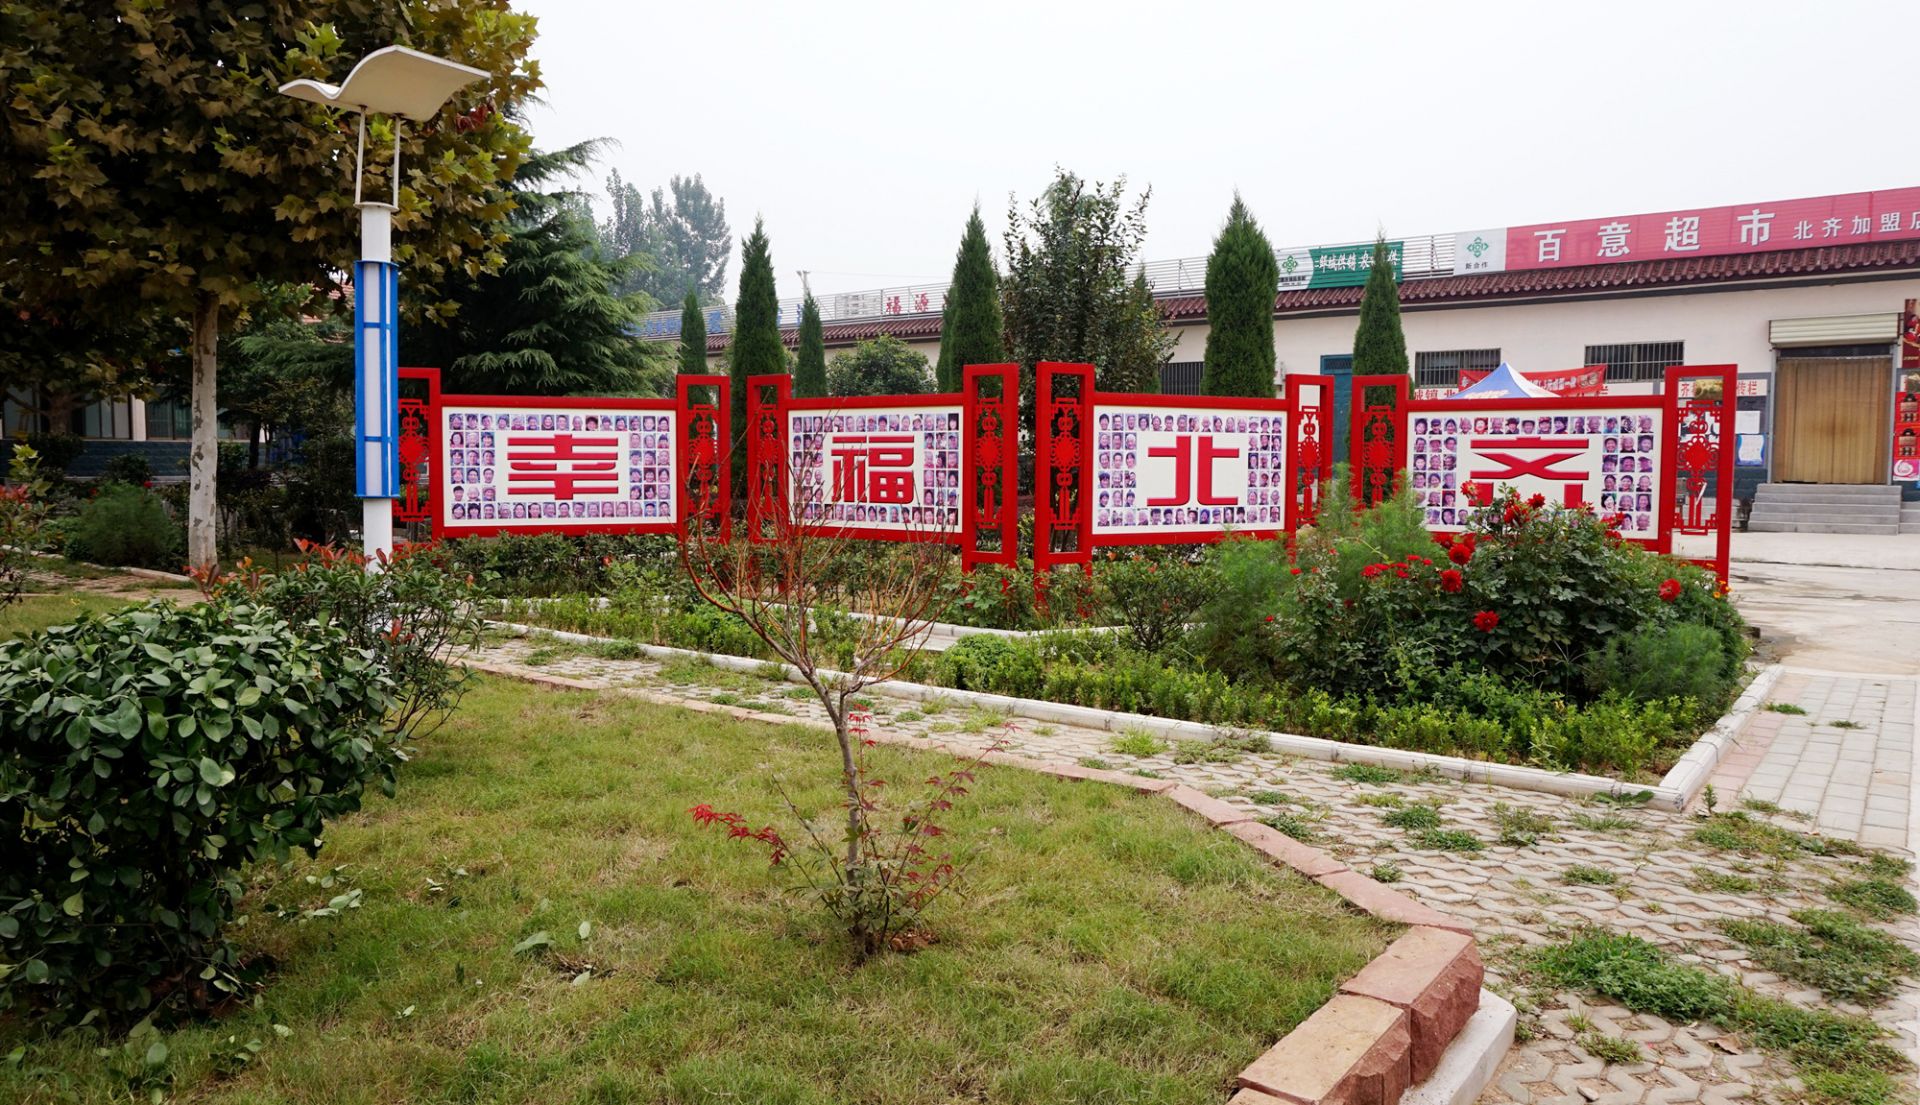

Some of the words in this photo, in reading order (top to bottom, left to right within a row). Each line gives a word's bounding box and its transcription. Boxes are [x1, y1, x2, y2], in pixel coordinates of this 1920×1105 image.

[1465, 261, 1489, 270] 新合作
[1533, 208, 1776, 263] 百意超市
[507, 433, 619, 500] 幸
[831, 435, 915, 504] 福
[1146, 435, 1240, 507] 北
[1467, 436, 1590, 510] 齐
